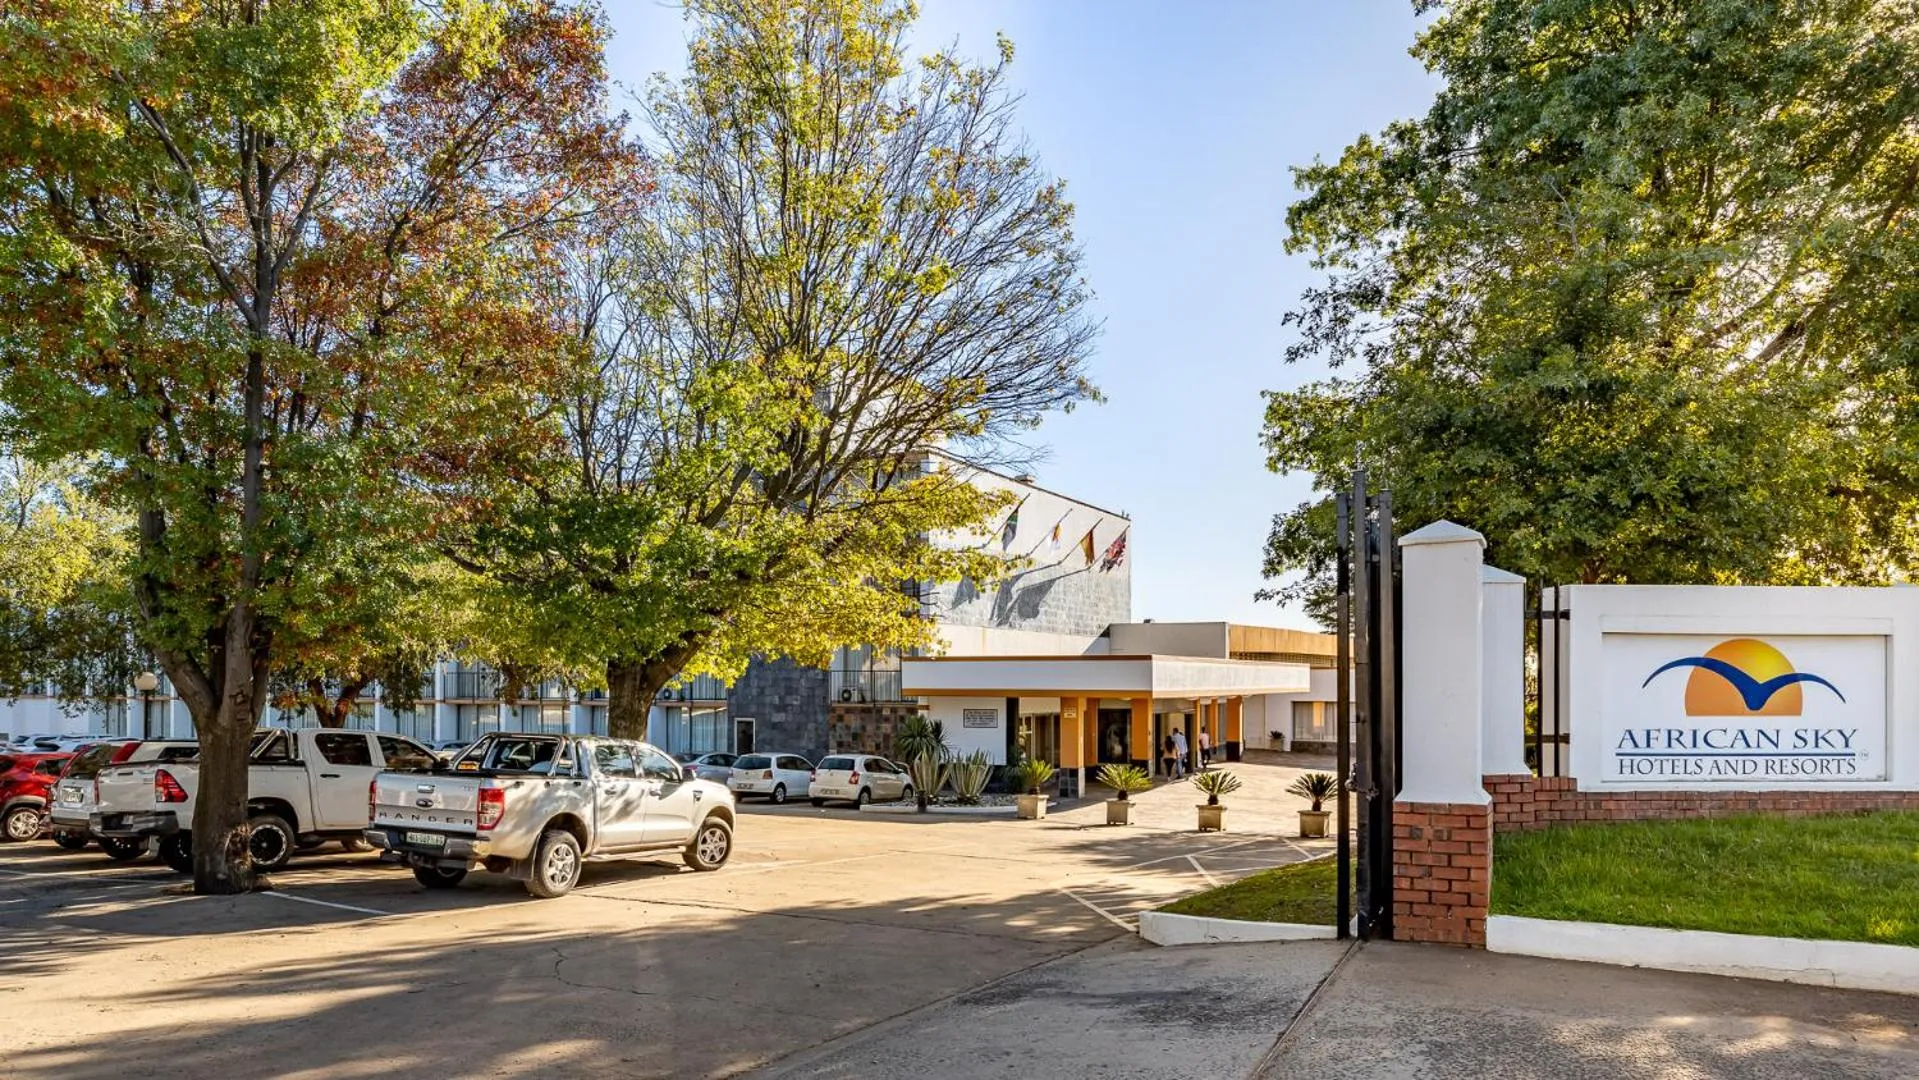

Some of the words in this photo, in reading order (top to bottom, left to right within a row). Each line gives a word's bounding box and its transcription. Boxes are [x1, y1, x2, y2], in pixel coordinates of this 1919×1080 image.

[1616, 727, 1780, 749] AFRICAN
[1792, 727, 1859, 749] SKY
[1618, 758, 1703, 775] HOTELS
[1708, 758, 1758, 775] AND
[1764, 758, 1857, 775] RESORTS
